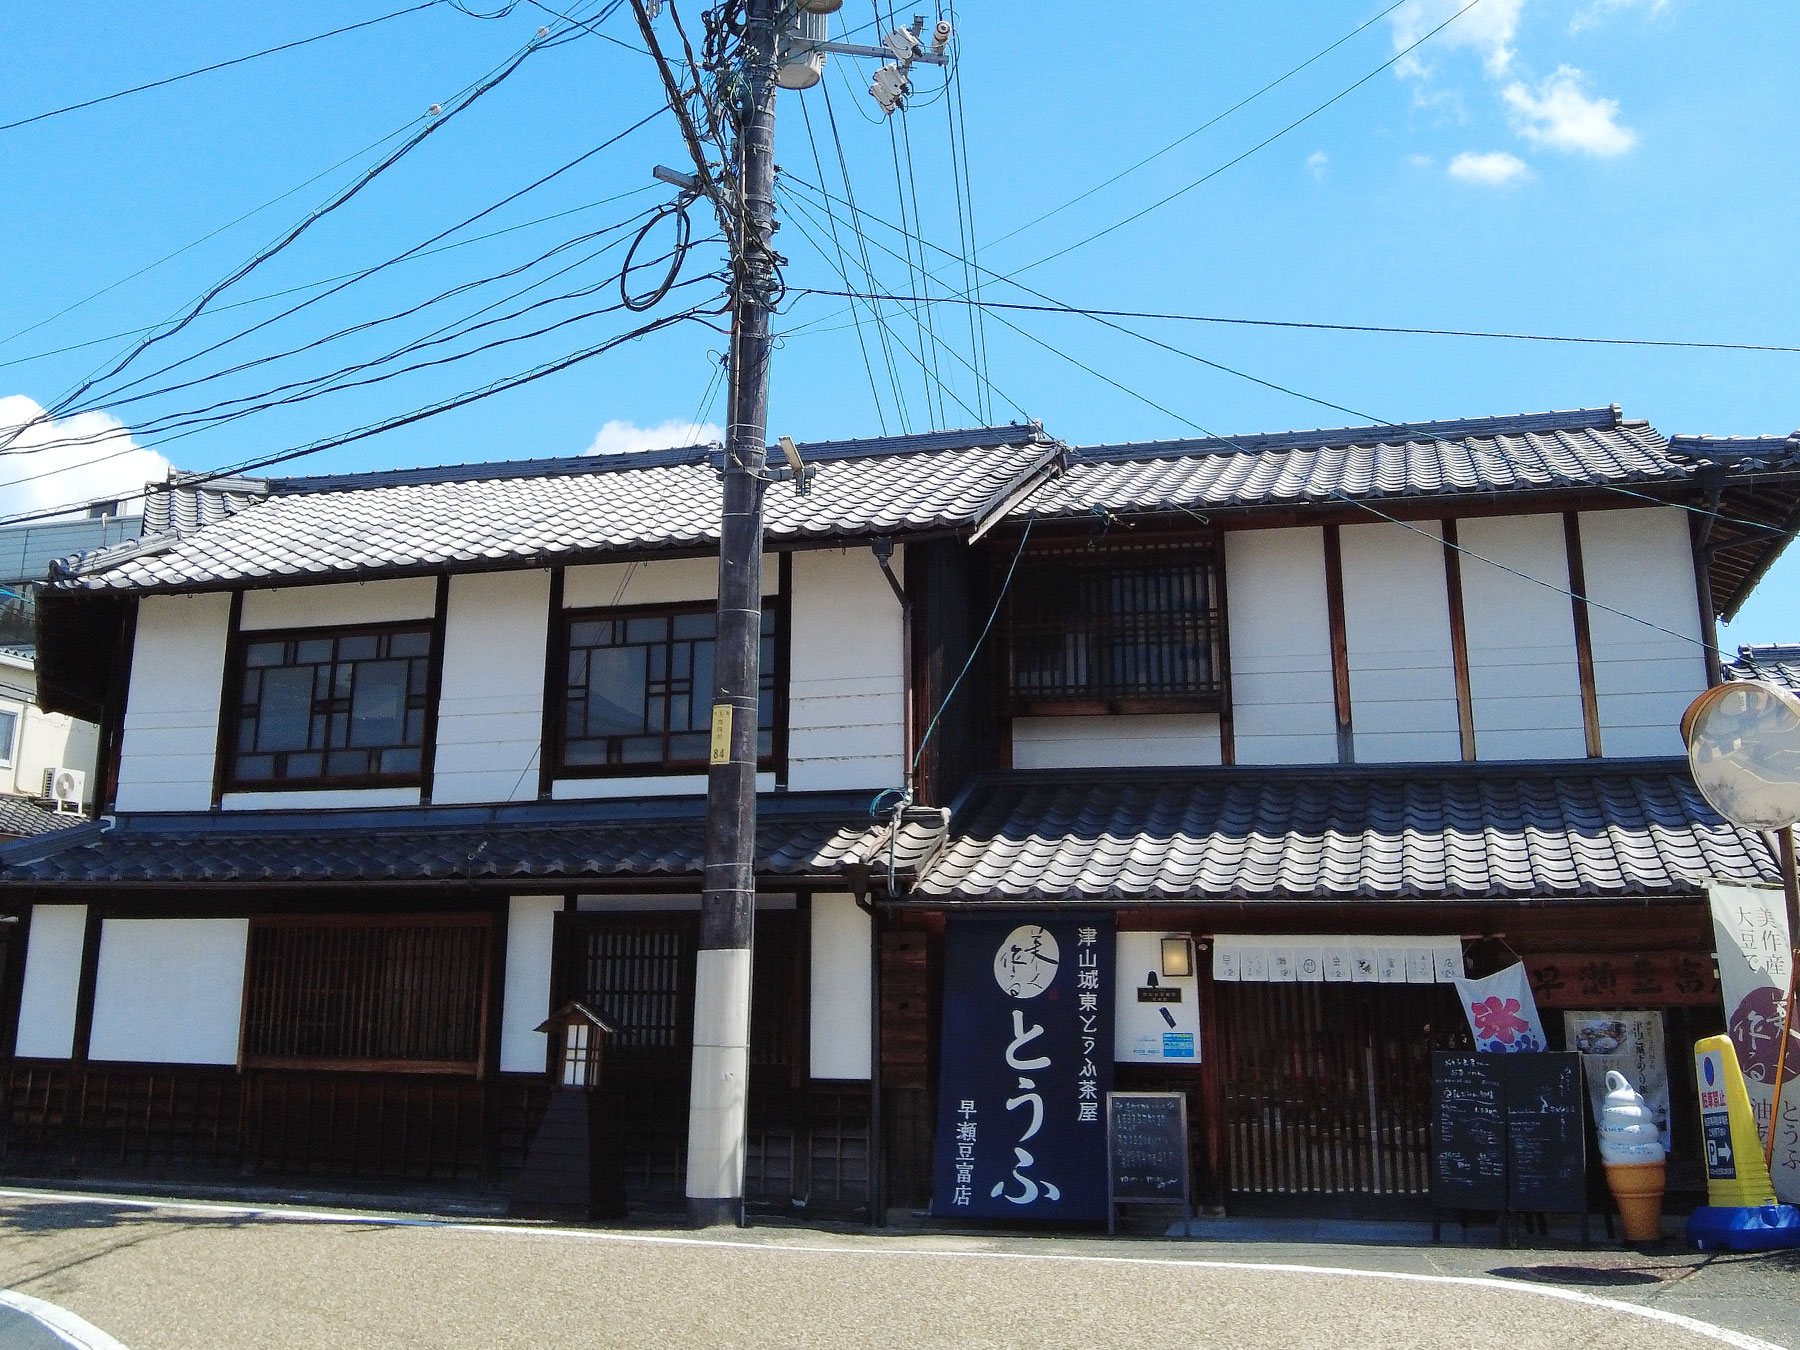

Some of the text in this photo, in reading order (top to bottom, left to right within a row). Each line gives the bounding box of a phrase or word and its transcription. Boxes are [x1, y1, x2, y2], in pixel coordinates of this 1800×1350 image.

[713, 748, 725, 759] 84
[1735, 906, 1758, 972] 大豆で
[1756, 907, 1786, 976] 美作産
[1077, 927, 1100, 1122] 津山城東とうふ茶屋
[991, 1009, 1061, 1205] とうふ
[953, 1100, 977, 1206] 早瀬豆富店
